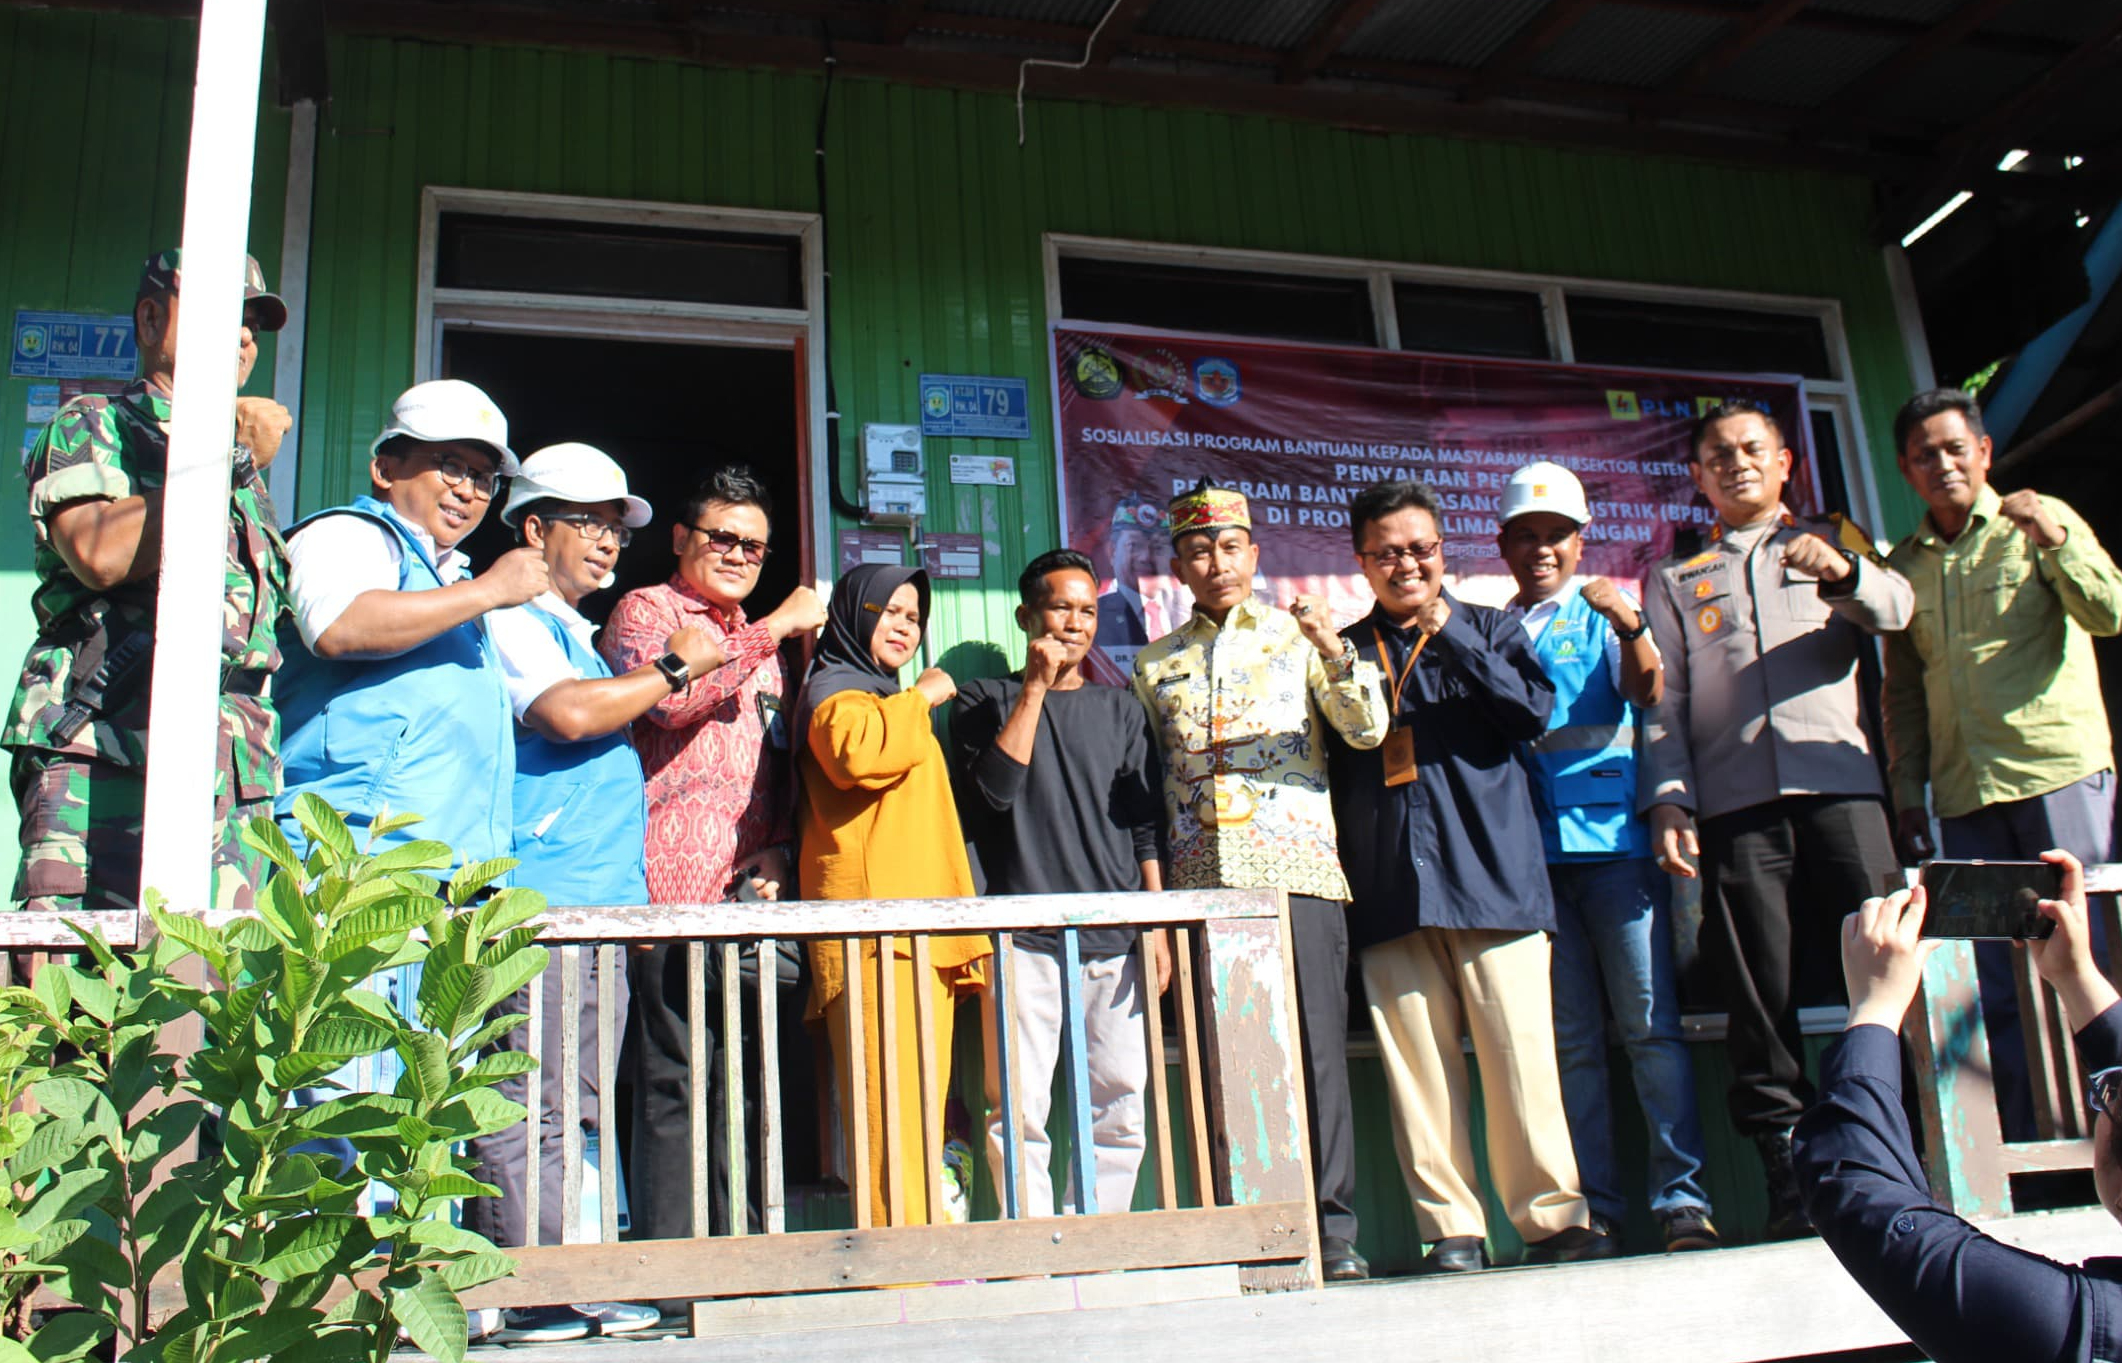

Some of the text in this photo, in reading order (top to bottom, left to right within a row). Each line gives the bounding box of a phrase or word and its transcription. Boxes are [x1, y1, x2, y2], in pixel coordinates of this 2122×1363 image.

[94, 326, 128, 357] 77
[982, 388, 1009, 415] 79
[1641, 398, 1691, 417] PLN
[1081, 427, 1190, 447] SOSIALISASI
[1193, 432, 1281, 453] PROGRAM
[1284, 440, 1365, 458] BANTUAN
[1368, 445, 1435, 462] KEPADA
[1642, 460, 1690, 476] KETEN
[1267, 507, 1290, 525] DI
[1589, 500, 1656, 520] ISTRIK
